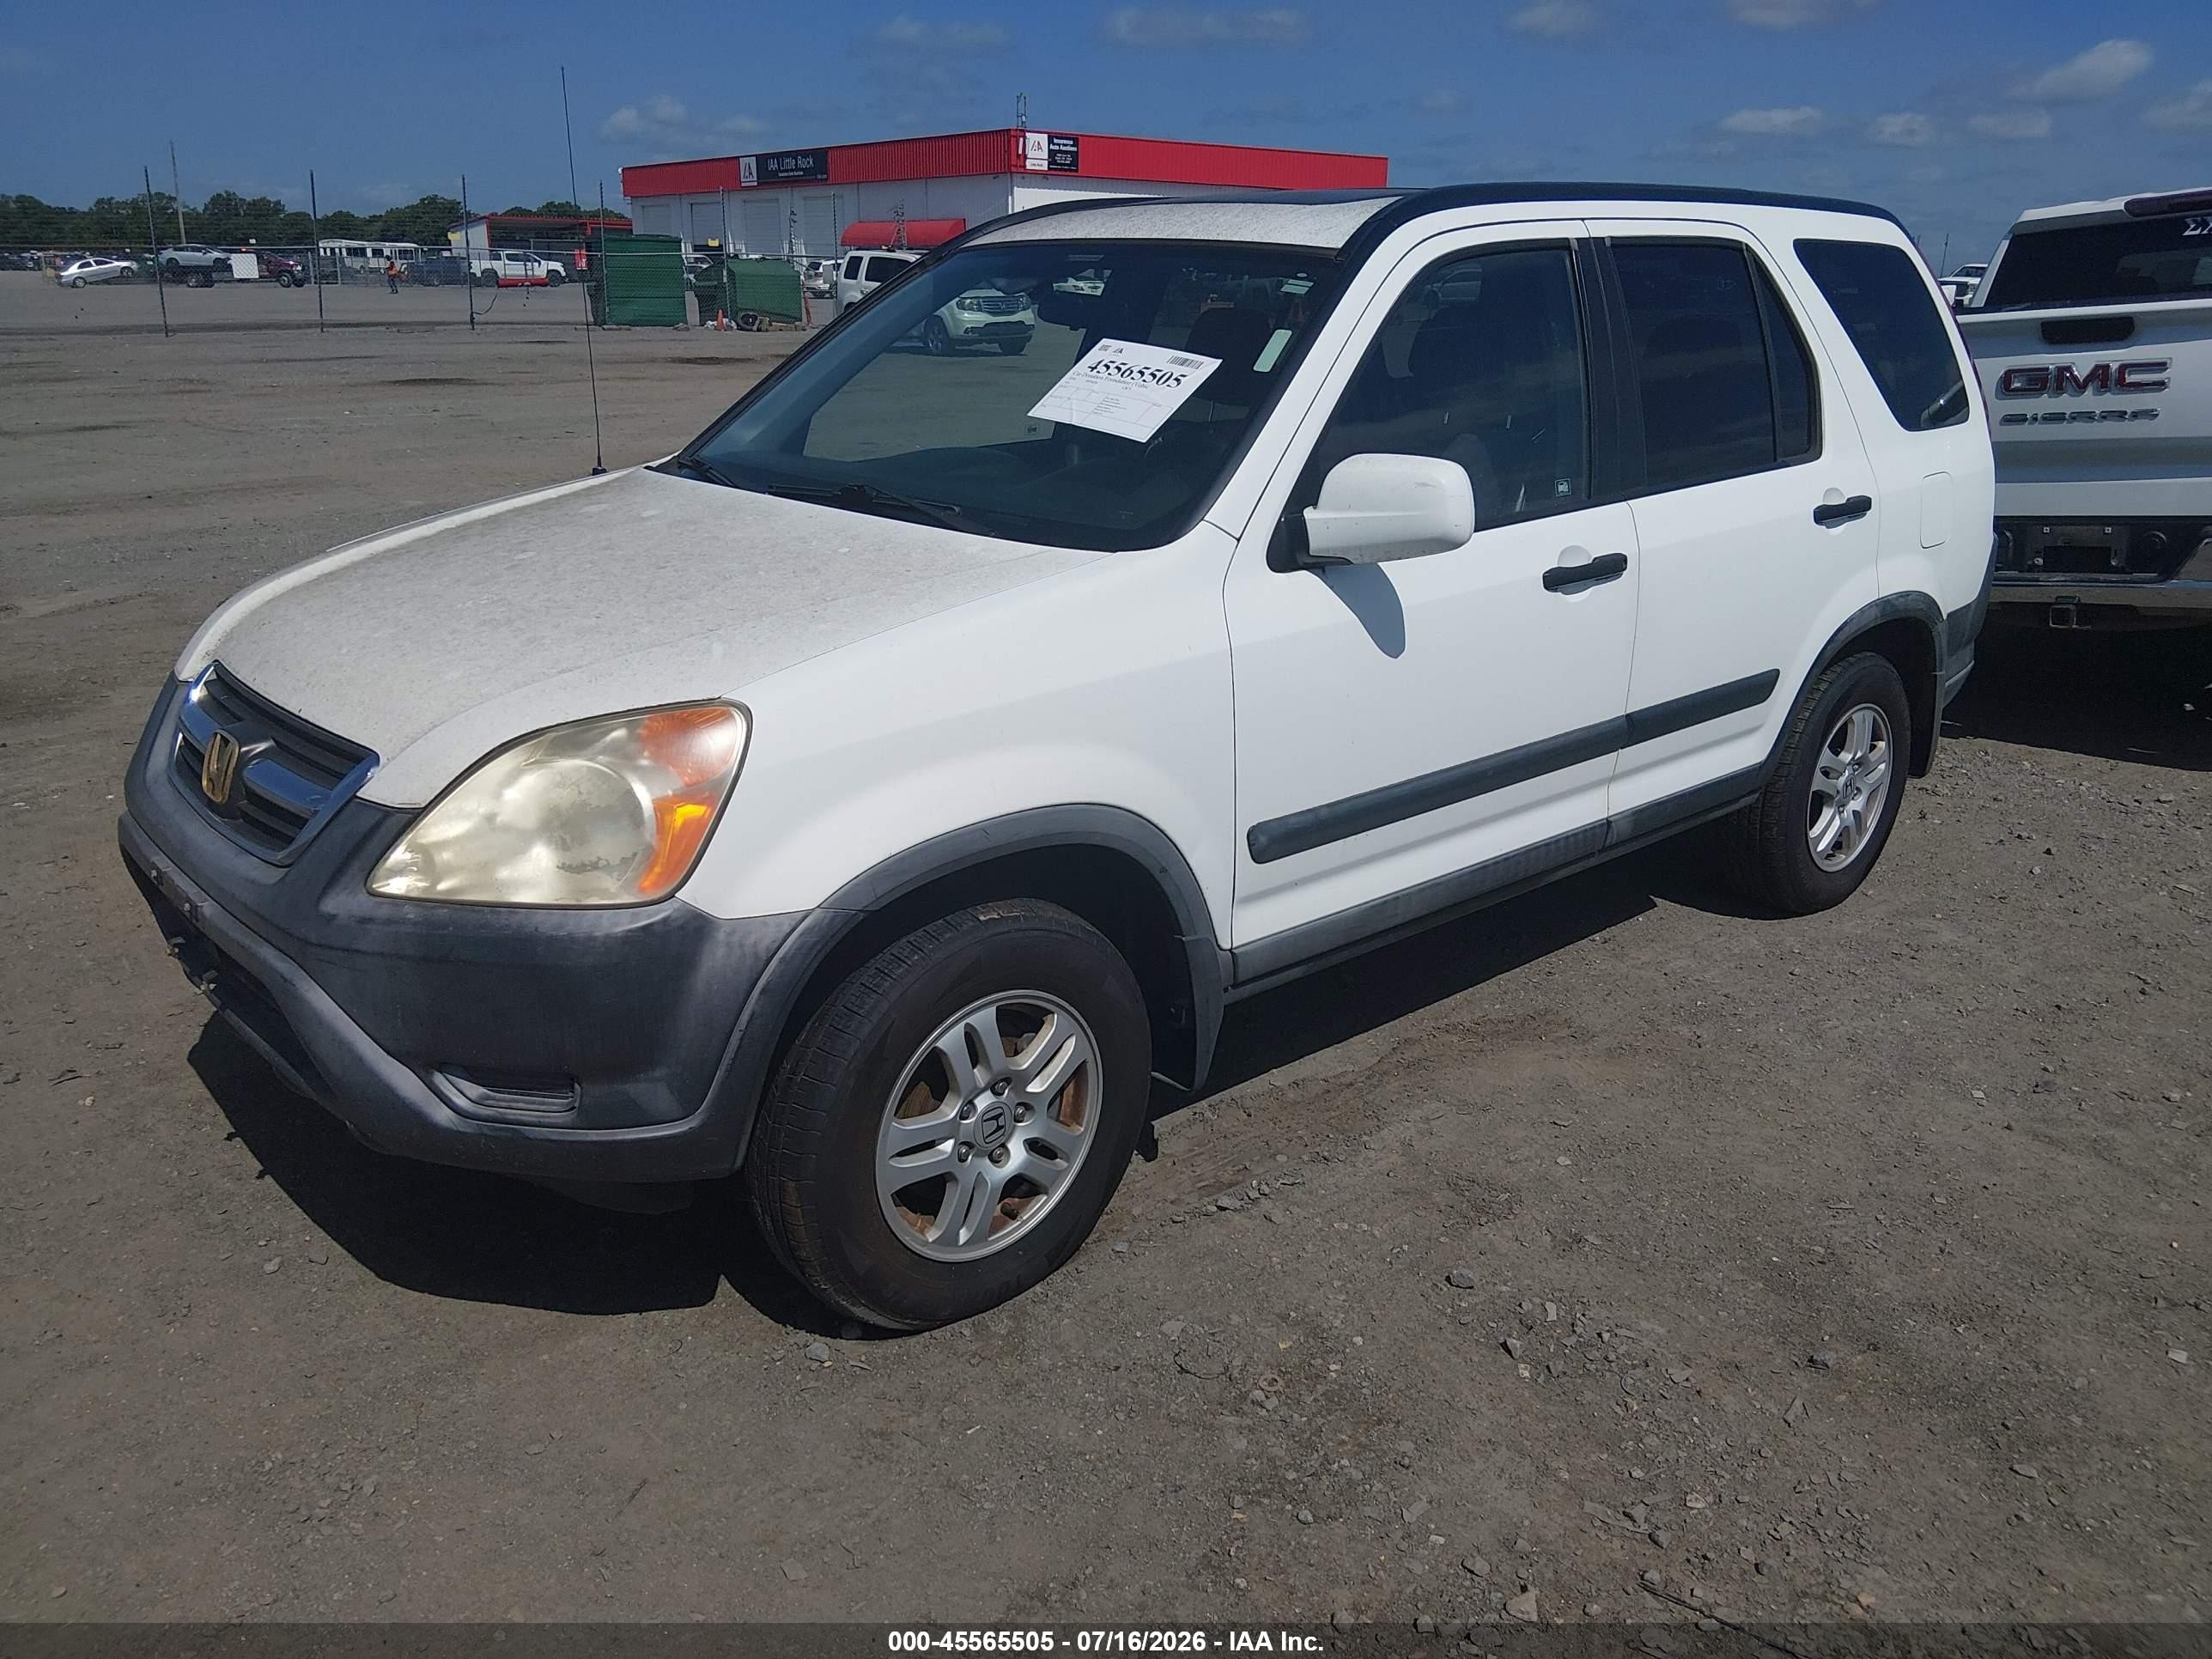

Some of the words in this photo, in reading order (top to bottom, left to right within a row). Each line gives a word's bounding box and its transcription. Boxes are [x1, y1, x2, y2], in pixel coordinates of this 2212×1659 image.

[768, 158, 778, 171] IAA
[780, 156, 796, 170] Little
[798, 155, 814, 169] Rock
[1087, 359, 1188, 388] 45565505
[1996, 358, 2172, 398] GMC
[2001, 408, 2160, 426] SIERRA
